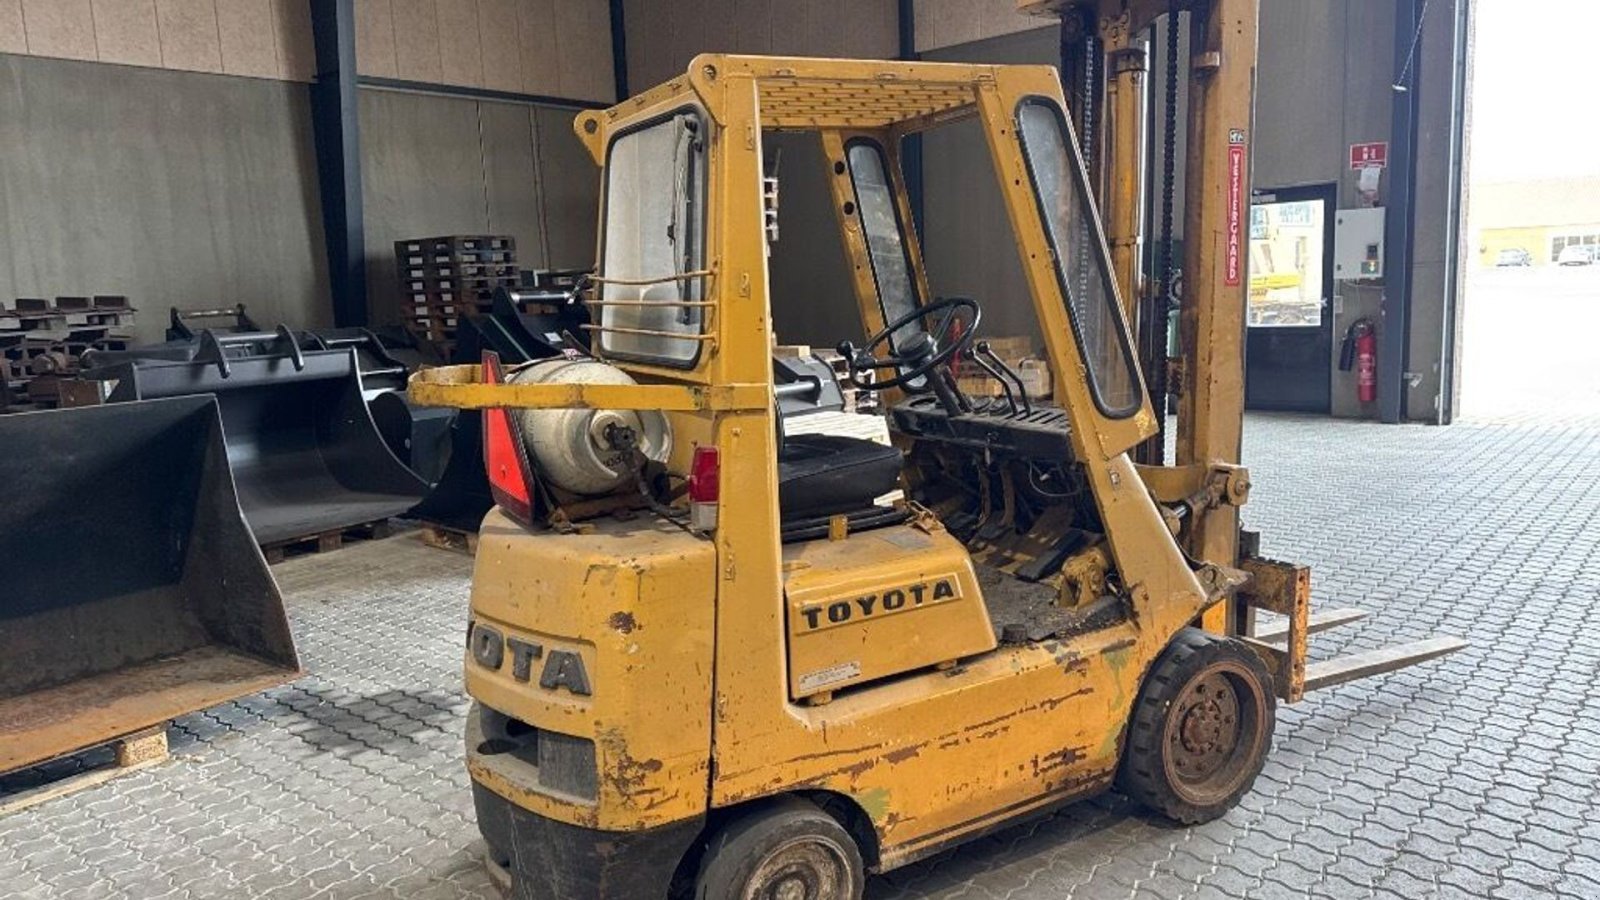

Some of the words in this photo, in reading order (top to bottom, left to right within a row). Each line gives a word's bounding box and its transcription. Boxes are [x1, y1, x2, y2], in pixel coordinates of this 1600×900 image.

[1229, 153, 1240, 279] VESTERGAARD
[801, 579, 954, 629] TOYOTA
[467, 621, 592, 696] OTA
